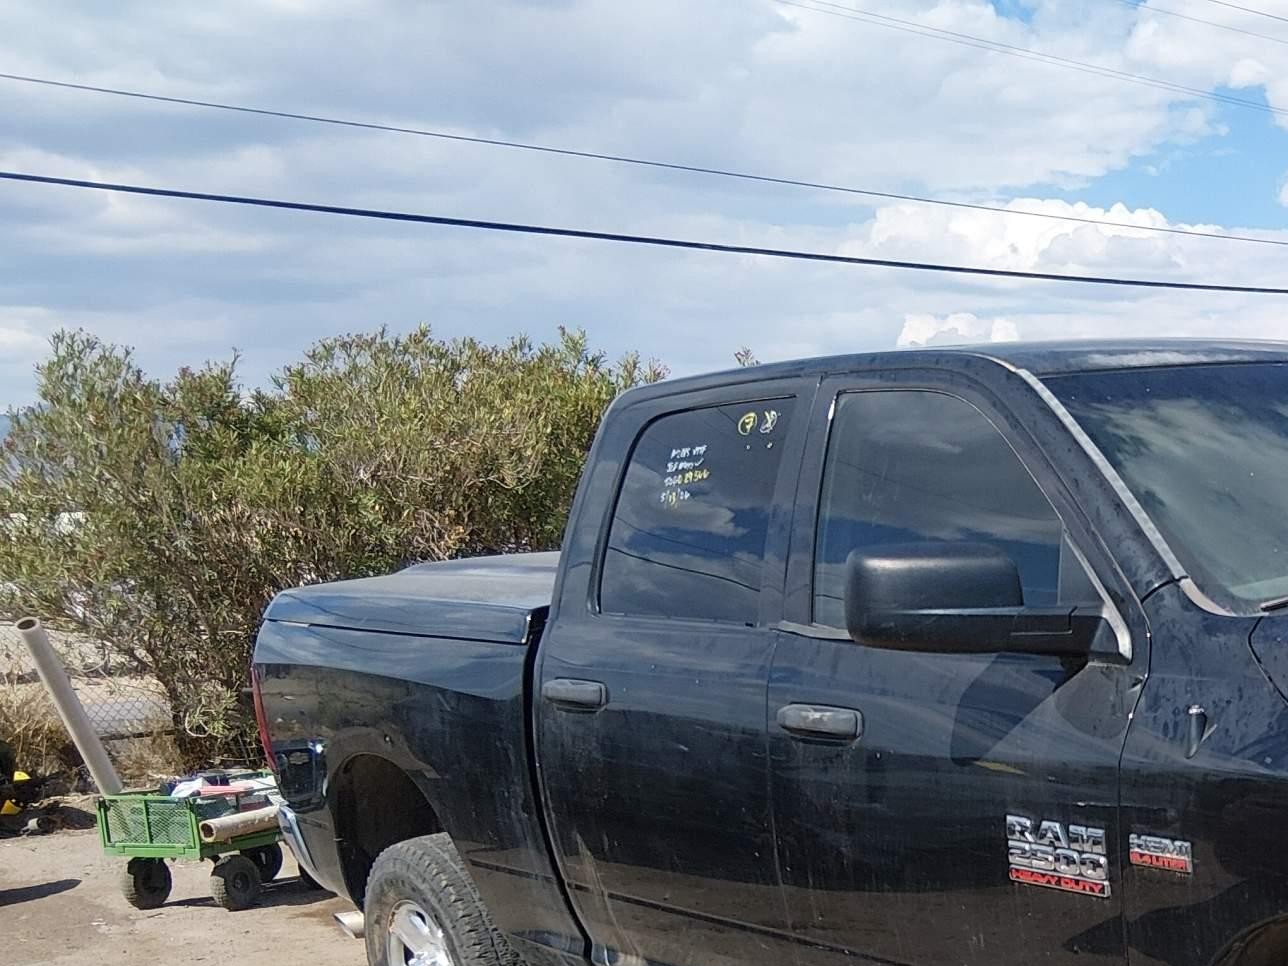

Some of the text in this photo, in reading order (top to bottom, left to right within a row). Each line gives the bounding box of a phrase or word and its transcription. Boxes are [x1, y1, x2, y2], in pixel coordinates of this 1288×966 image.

[1006, 814, 1106, 854] RAM
[1129, 833, 1192, 860] HEMI
[1008, 840, 1108, 879] 2500
[1012, 868, 1104, 894] HEAVY DUTY
